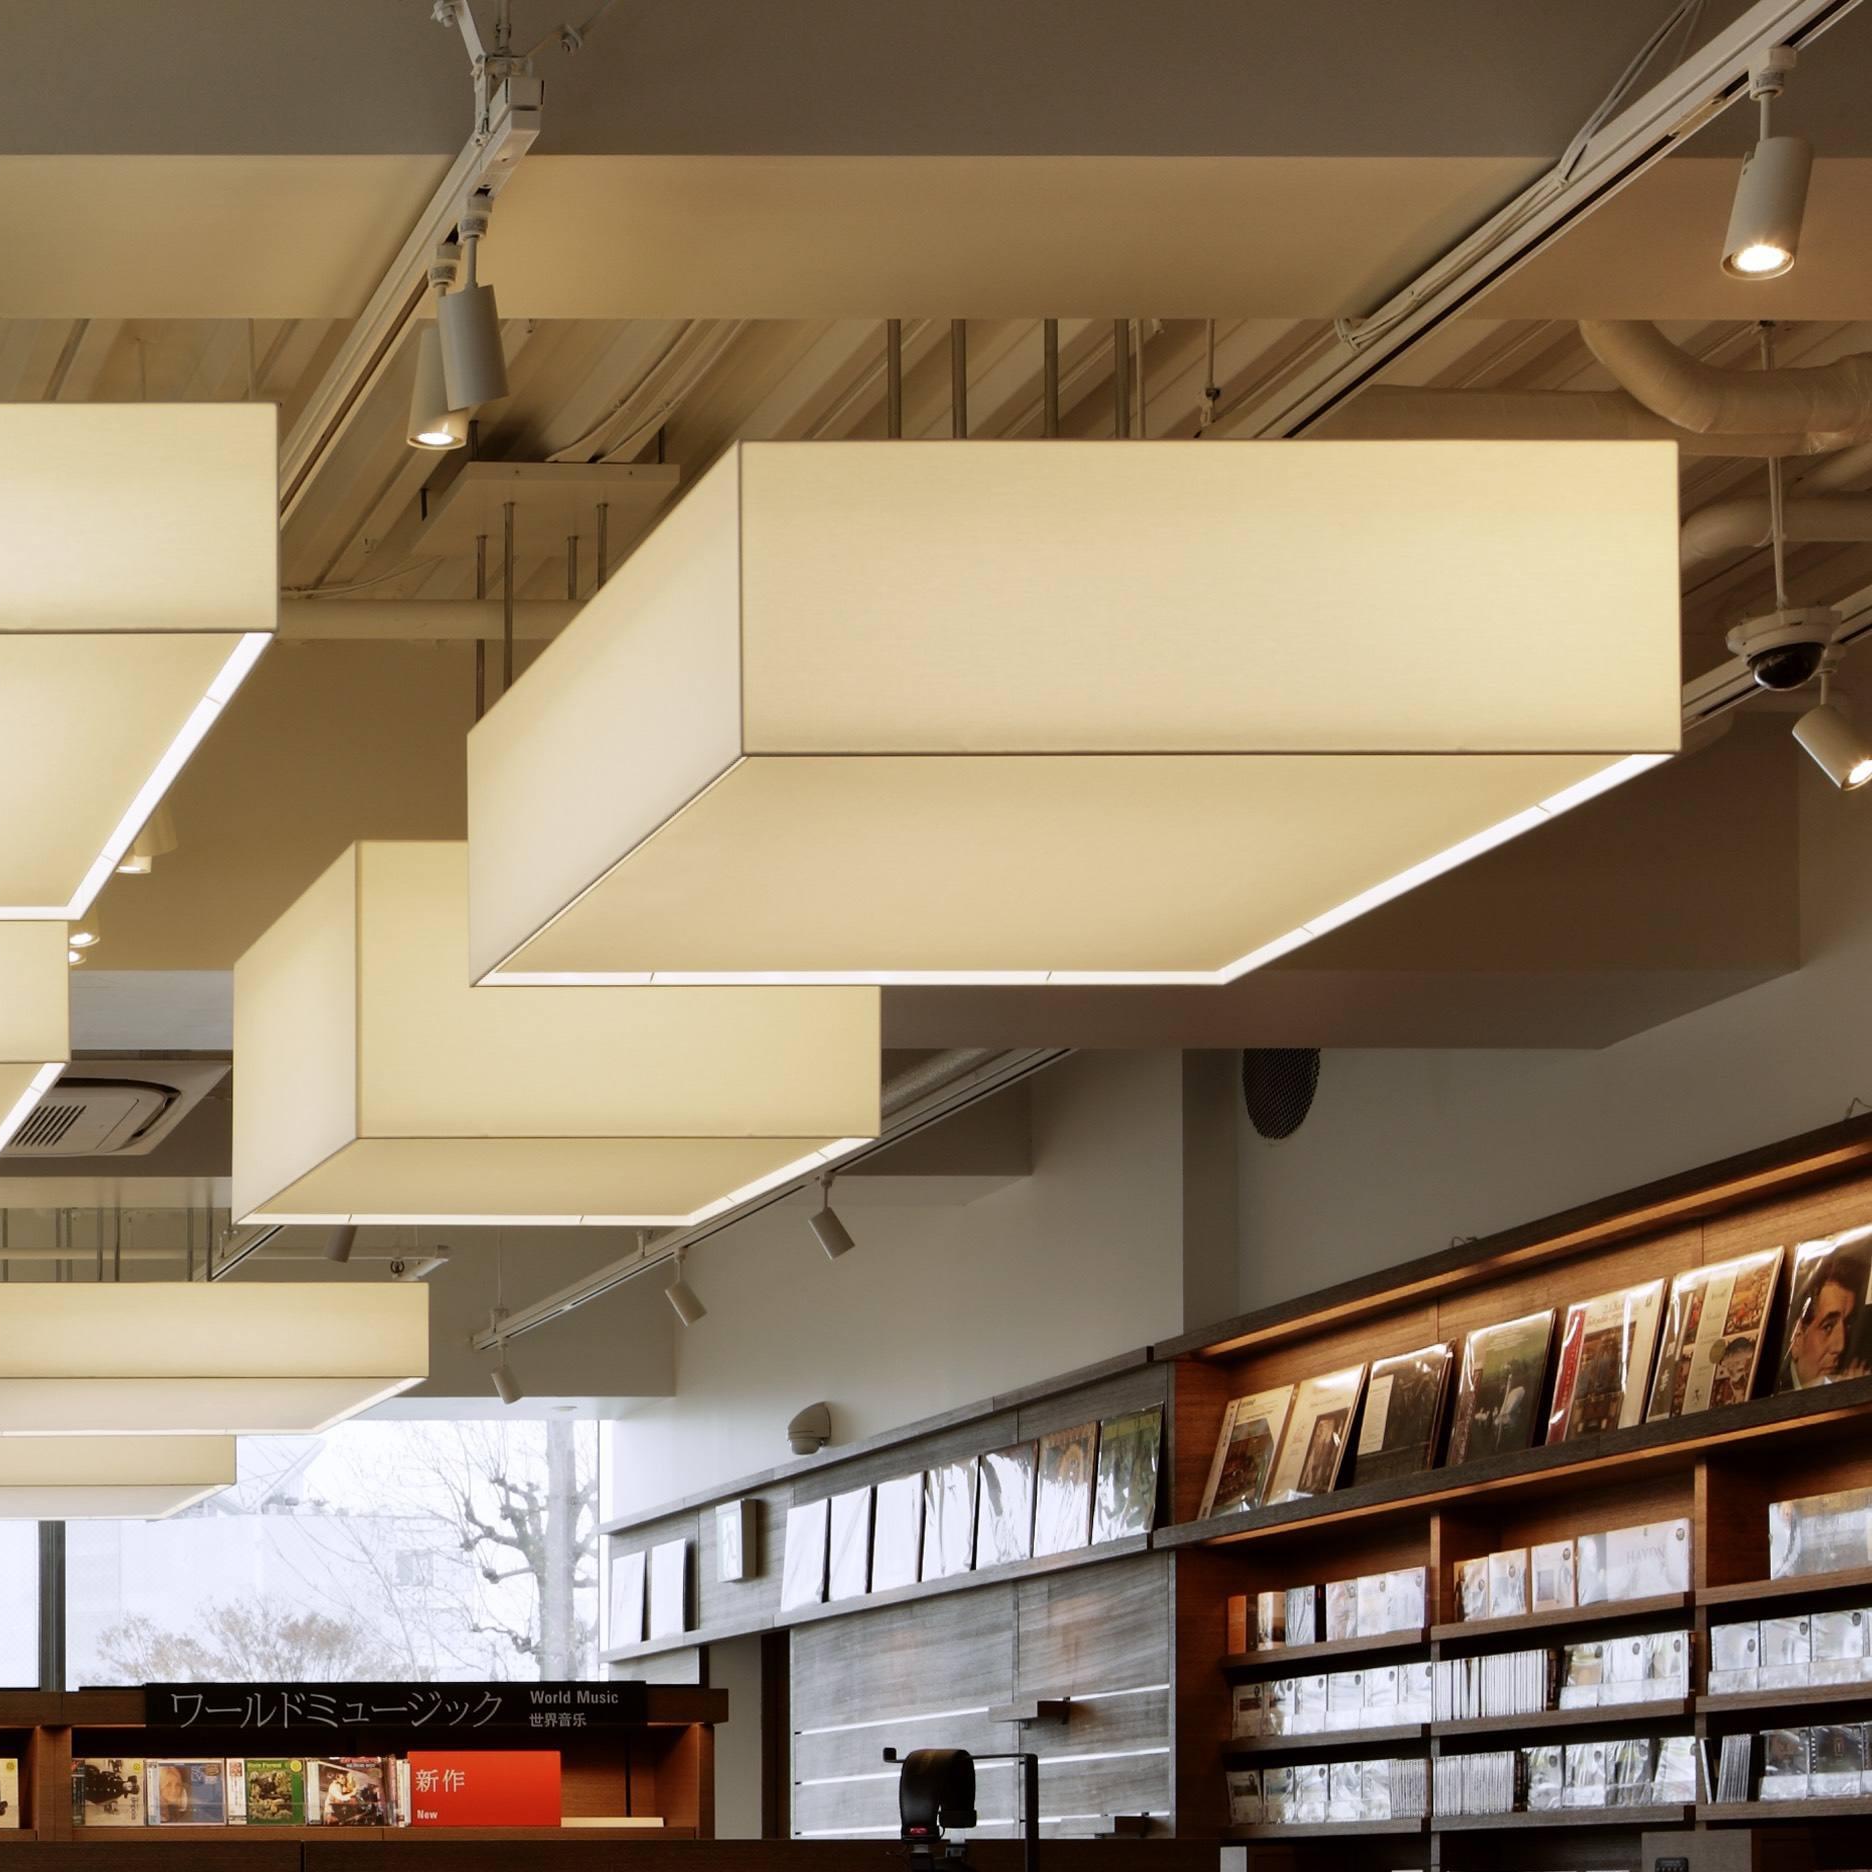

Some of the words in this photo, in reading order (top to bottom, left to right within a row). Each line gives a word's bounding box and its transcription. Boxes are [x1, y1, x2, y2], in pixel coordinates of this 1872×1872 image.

[530, 1690, 572, 1705] World
[577, 1690, 619, 1705] Music
[171, 1690, 503, 1729] ワールドミュージック
[529, 1712, 587, 1727] 世界音乐
[415, 1769, 466, 1793] 新作
[417, 1809, 439, 1820] New
